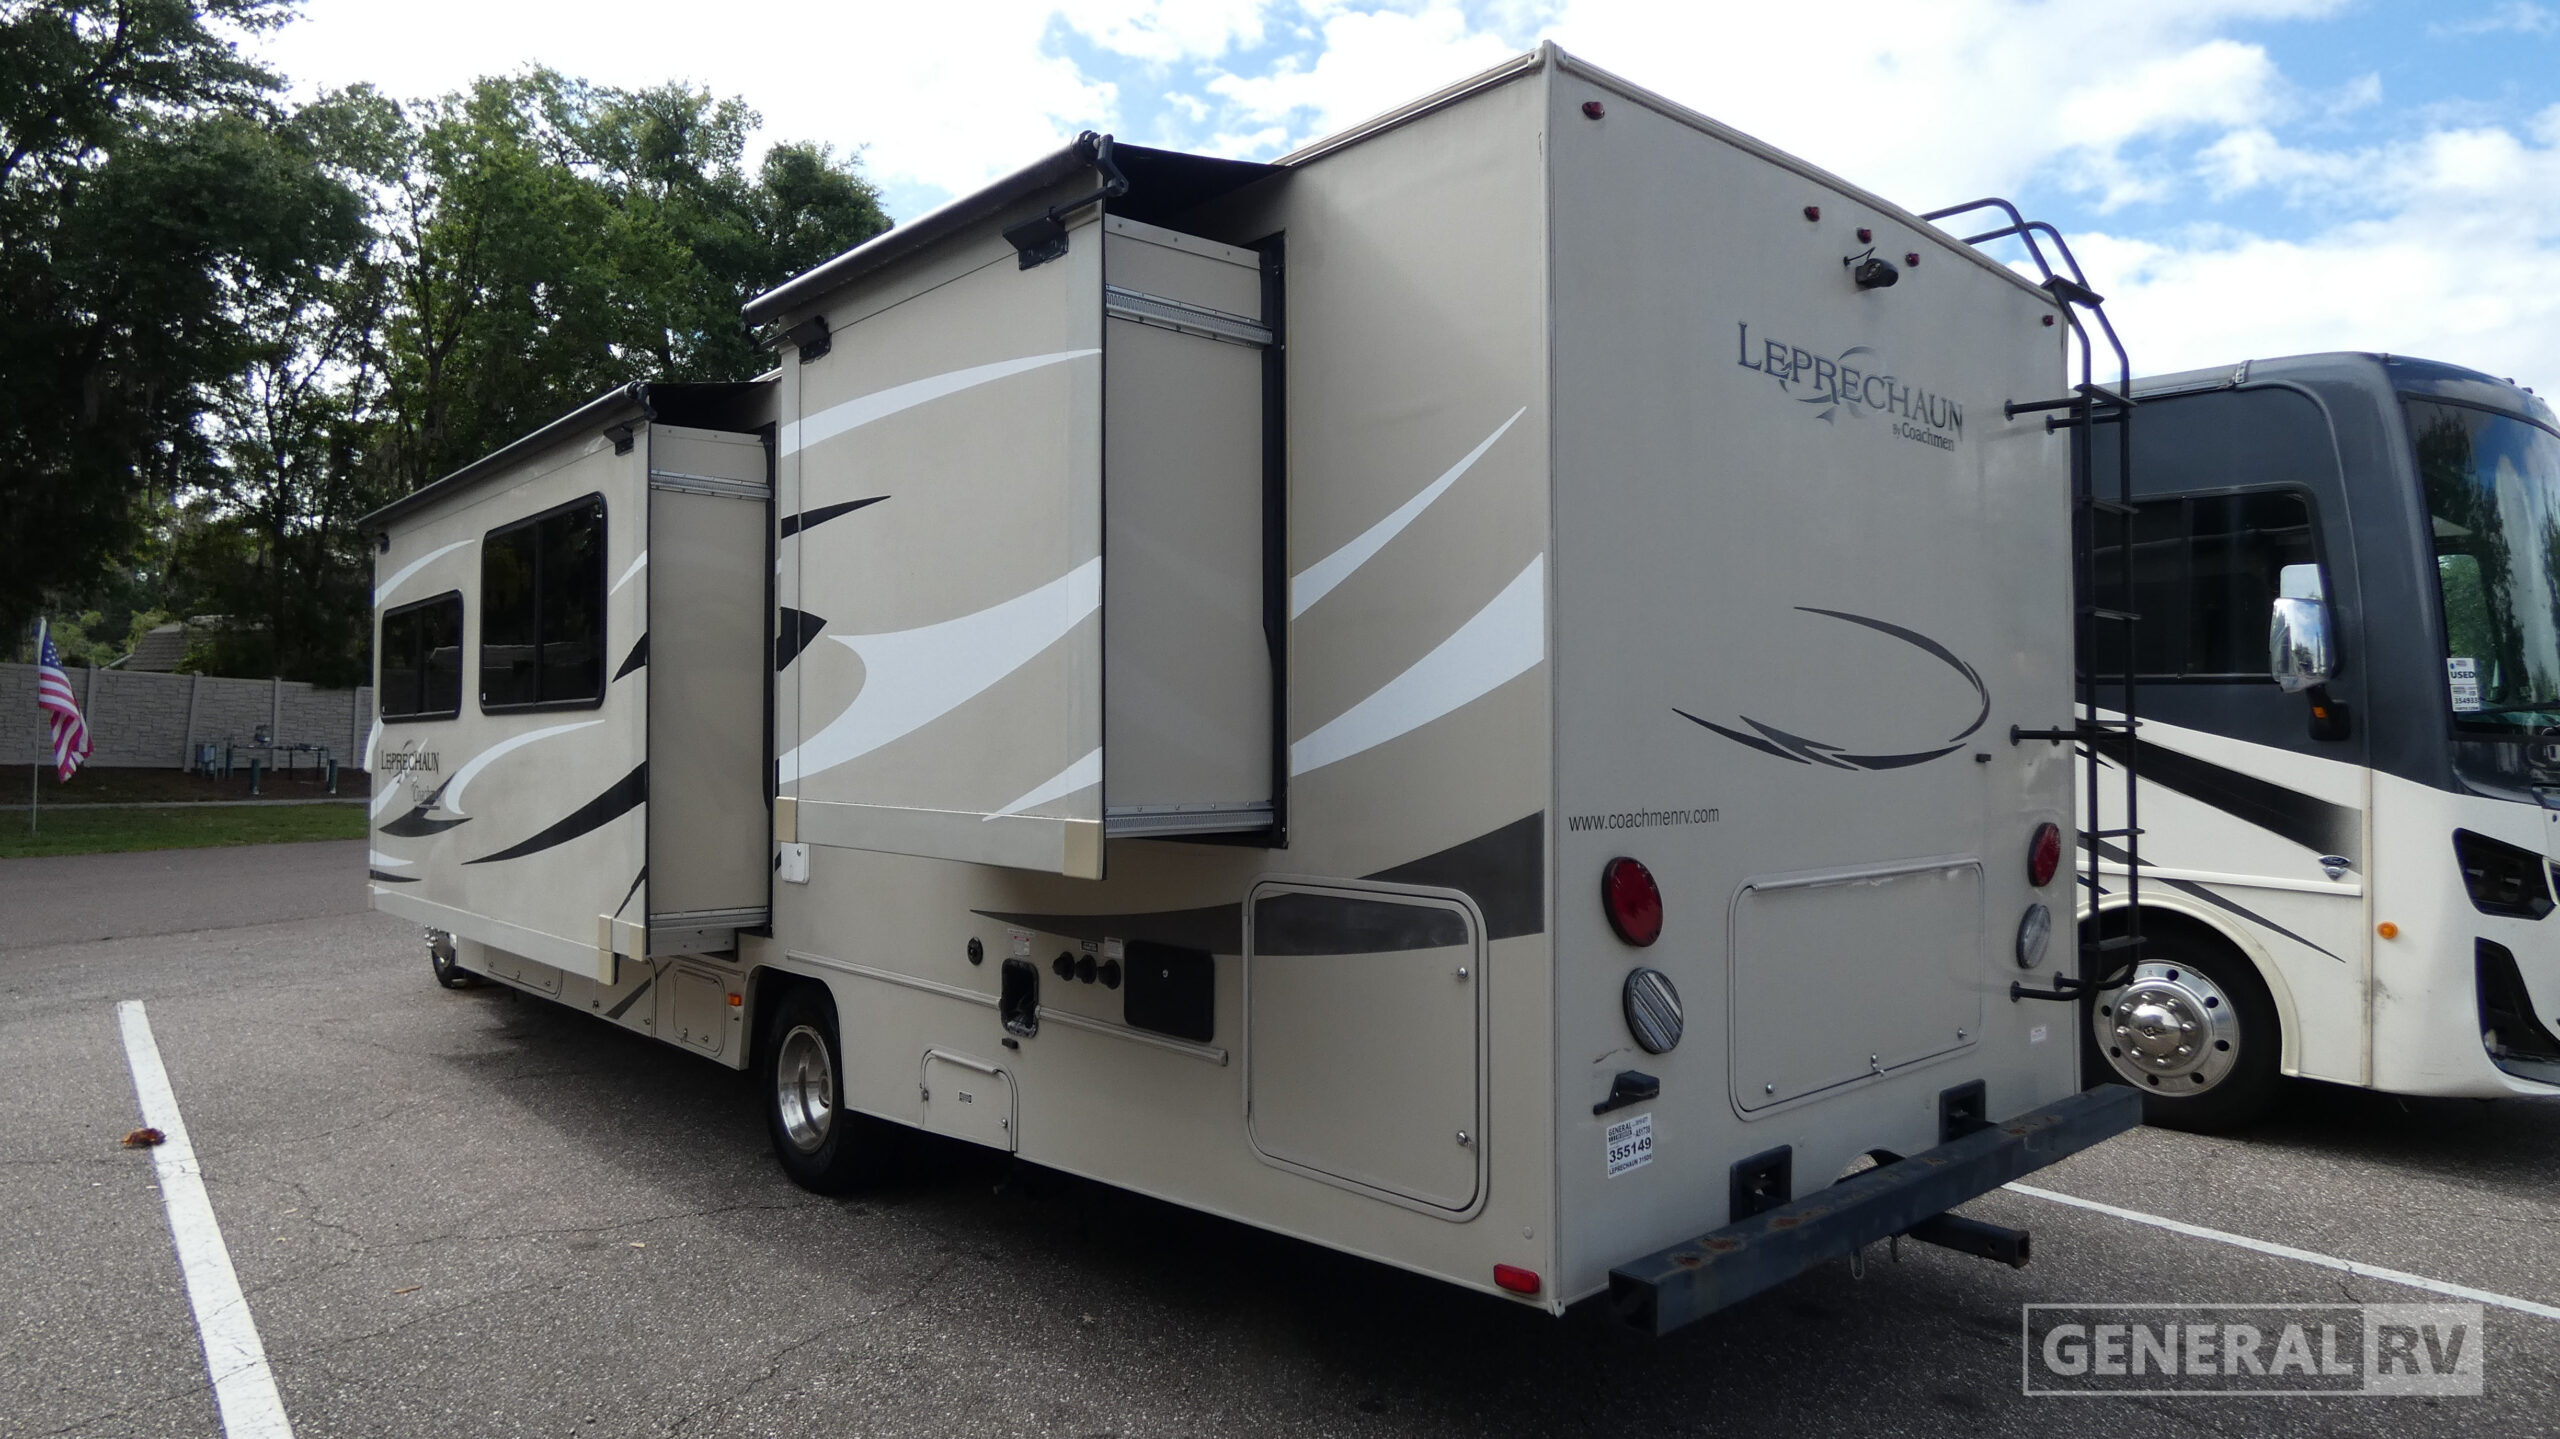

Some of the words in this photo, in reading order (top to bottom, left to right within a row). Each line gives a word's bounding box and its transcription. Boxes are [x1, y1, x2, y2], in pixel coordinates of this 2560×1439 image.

[1737, 320, 1964, 442] LEPRECHAUN
[1901, 422, 1955, 452] Coachmen
[2450, 671, 2476, 679] USED
[380, 750, 440, 775] LEPRECHAUN
[1568, 808, 1720, 832] www.coachmenrv.com
[1609, 1137, 1652, 1163] 355149
[1608, 1159, 1639, 1175] LEPRECHAUN
